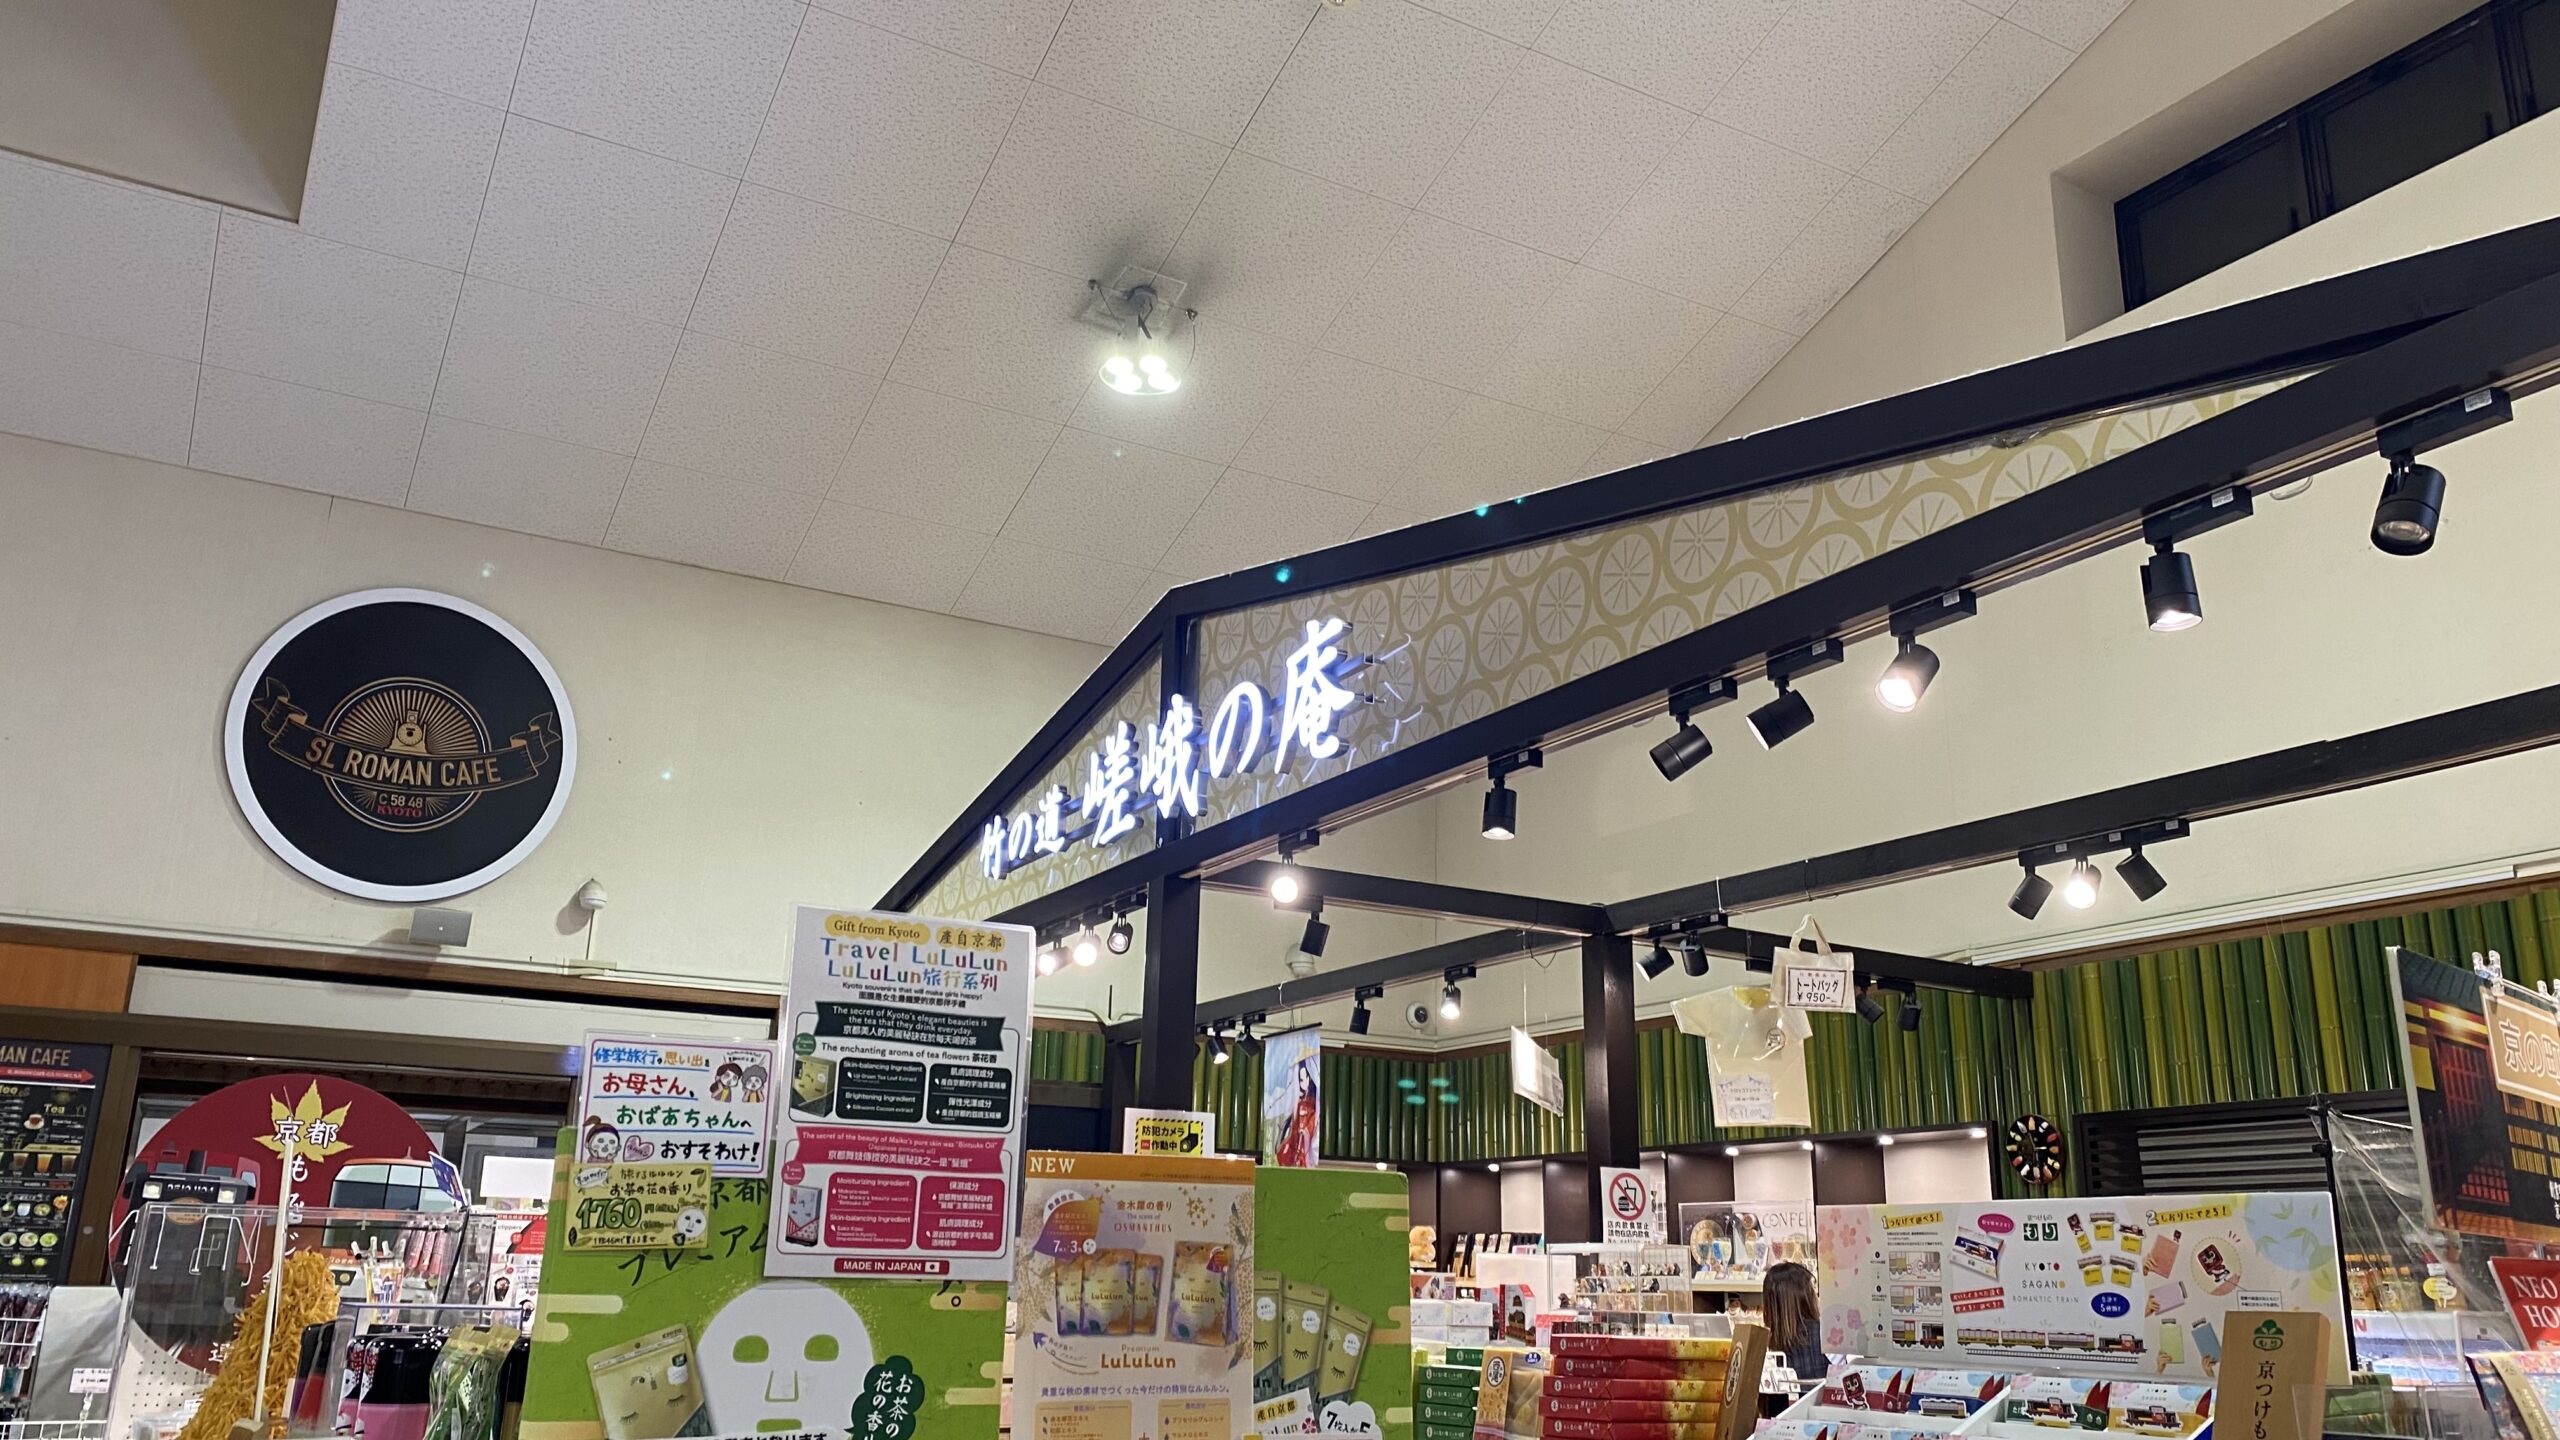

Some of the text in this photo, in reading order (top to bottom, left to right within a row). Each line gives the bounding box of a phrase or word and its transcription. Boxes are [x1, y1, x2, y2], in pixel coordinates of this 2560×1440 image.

[980, 617, 1354, 880] 竹の道 嵯峨の庵
[305, 736, 502, 788] SL ROMAN CAFE
[378, 793, 423, 808] C 58 48
[377, 805, 422, 817] KYOTO
[834, 920, 920, 940] Gift from Kyoto
[938, 929, 1002, 951] 產自京都
[820, 937, 1008, 972] Travel LuLuLun
[827, 959, 998, 993] LuLuLun旅行系列
[1797, 977, 1839, 993] トートバッグ
[842, 982, 982, 1001] Kyoto souvenirs that will make girls happy!
[832, 1005, 848, 1015] The
[850, 1008, 875, 1017] secret
[876, 1009, 887, 1018] of
[886, 1010, 916, 1022] Kyoto's
[917, 1014, 946, 1026] elegant
[948, 1016, 979, 1026] beauties
[848, 1016, 973, 1036] the tea that they drink everyday.
[31, 1047, 72, 1067] CAFE
[822, 1042, 838, 1052] The
[839, 1044, 887, 1057] enchanting
[888, 1048, 915, 1057] aroma
[916, 1049, 926, 1058] of
[927, 1050, 941, 1059] tea
[941, 1051, 970, 1061] flowers
[890, 1063, 923, 1074] Ingredient
[845, 1091, 916, 1104] Brightening Ingredient
[43, 1103, 65, 1114] Tea
[616, 1104, 752, 1129] おばあちゃんへ
[272, 1116, 338, 1149] 京都
[803, 1132, 815, 1140] The
[816, 1133, 836, 1141] secret
[837, 1133, 845, 1141] of
[845, 1133, 857, 1141] the
[857, 1135, 878, 1144] beauty
[880, 1135, 888, 1144] of
[914, 1138, 929, 1147] pure
[929, 1139, 942, 1147] skin
[1142, 1125, 1185, 1138] 防犯カメラ
[1151, 1140, 1178, 1151] 作動中
[1029, 1156, 1077, 1174] NEW
[609, 1180, 692, 1197] お茶の花の香り
[836, 1176, 911, 1188] Moisturizing Ingredient
[576, 1197, 642, 1230] 1760
[877, 1215, 911, 1225] Ingredient
[1113, 1222, 1172, 1233] OSMANTHUS
[2023, 1222, 2059, 1241] もり
[843, 1260, 922, 1271] MADE IN JAPAN
[2510, 1275, 2559, 1300] NEO
[2012, 1295, 2079, 1303] ROMANTIC TRAIN
[2523, 1304, 2560, 1329] HO
[1100, 1352, 1177, 1370] LuLuLun
[885, 1373, 914, 1439] お茶の
